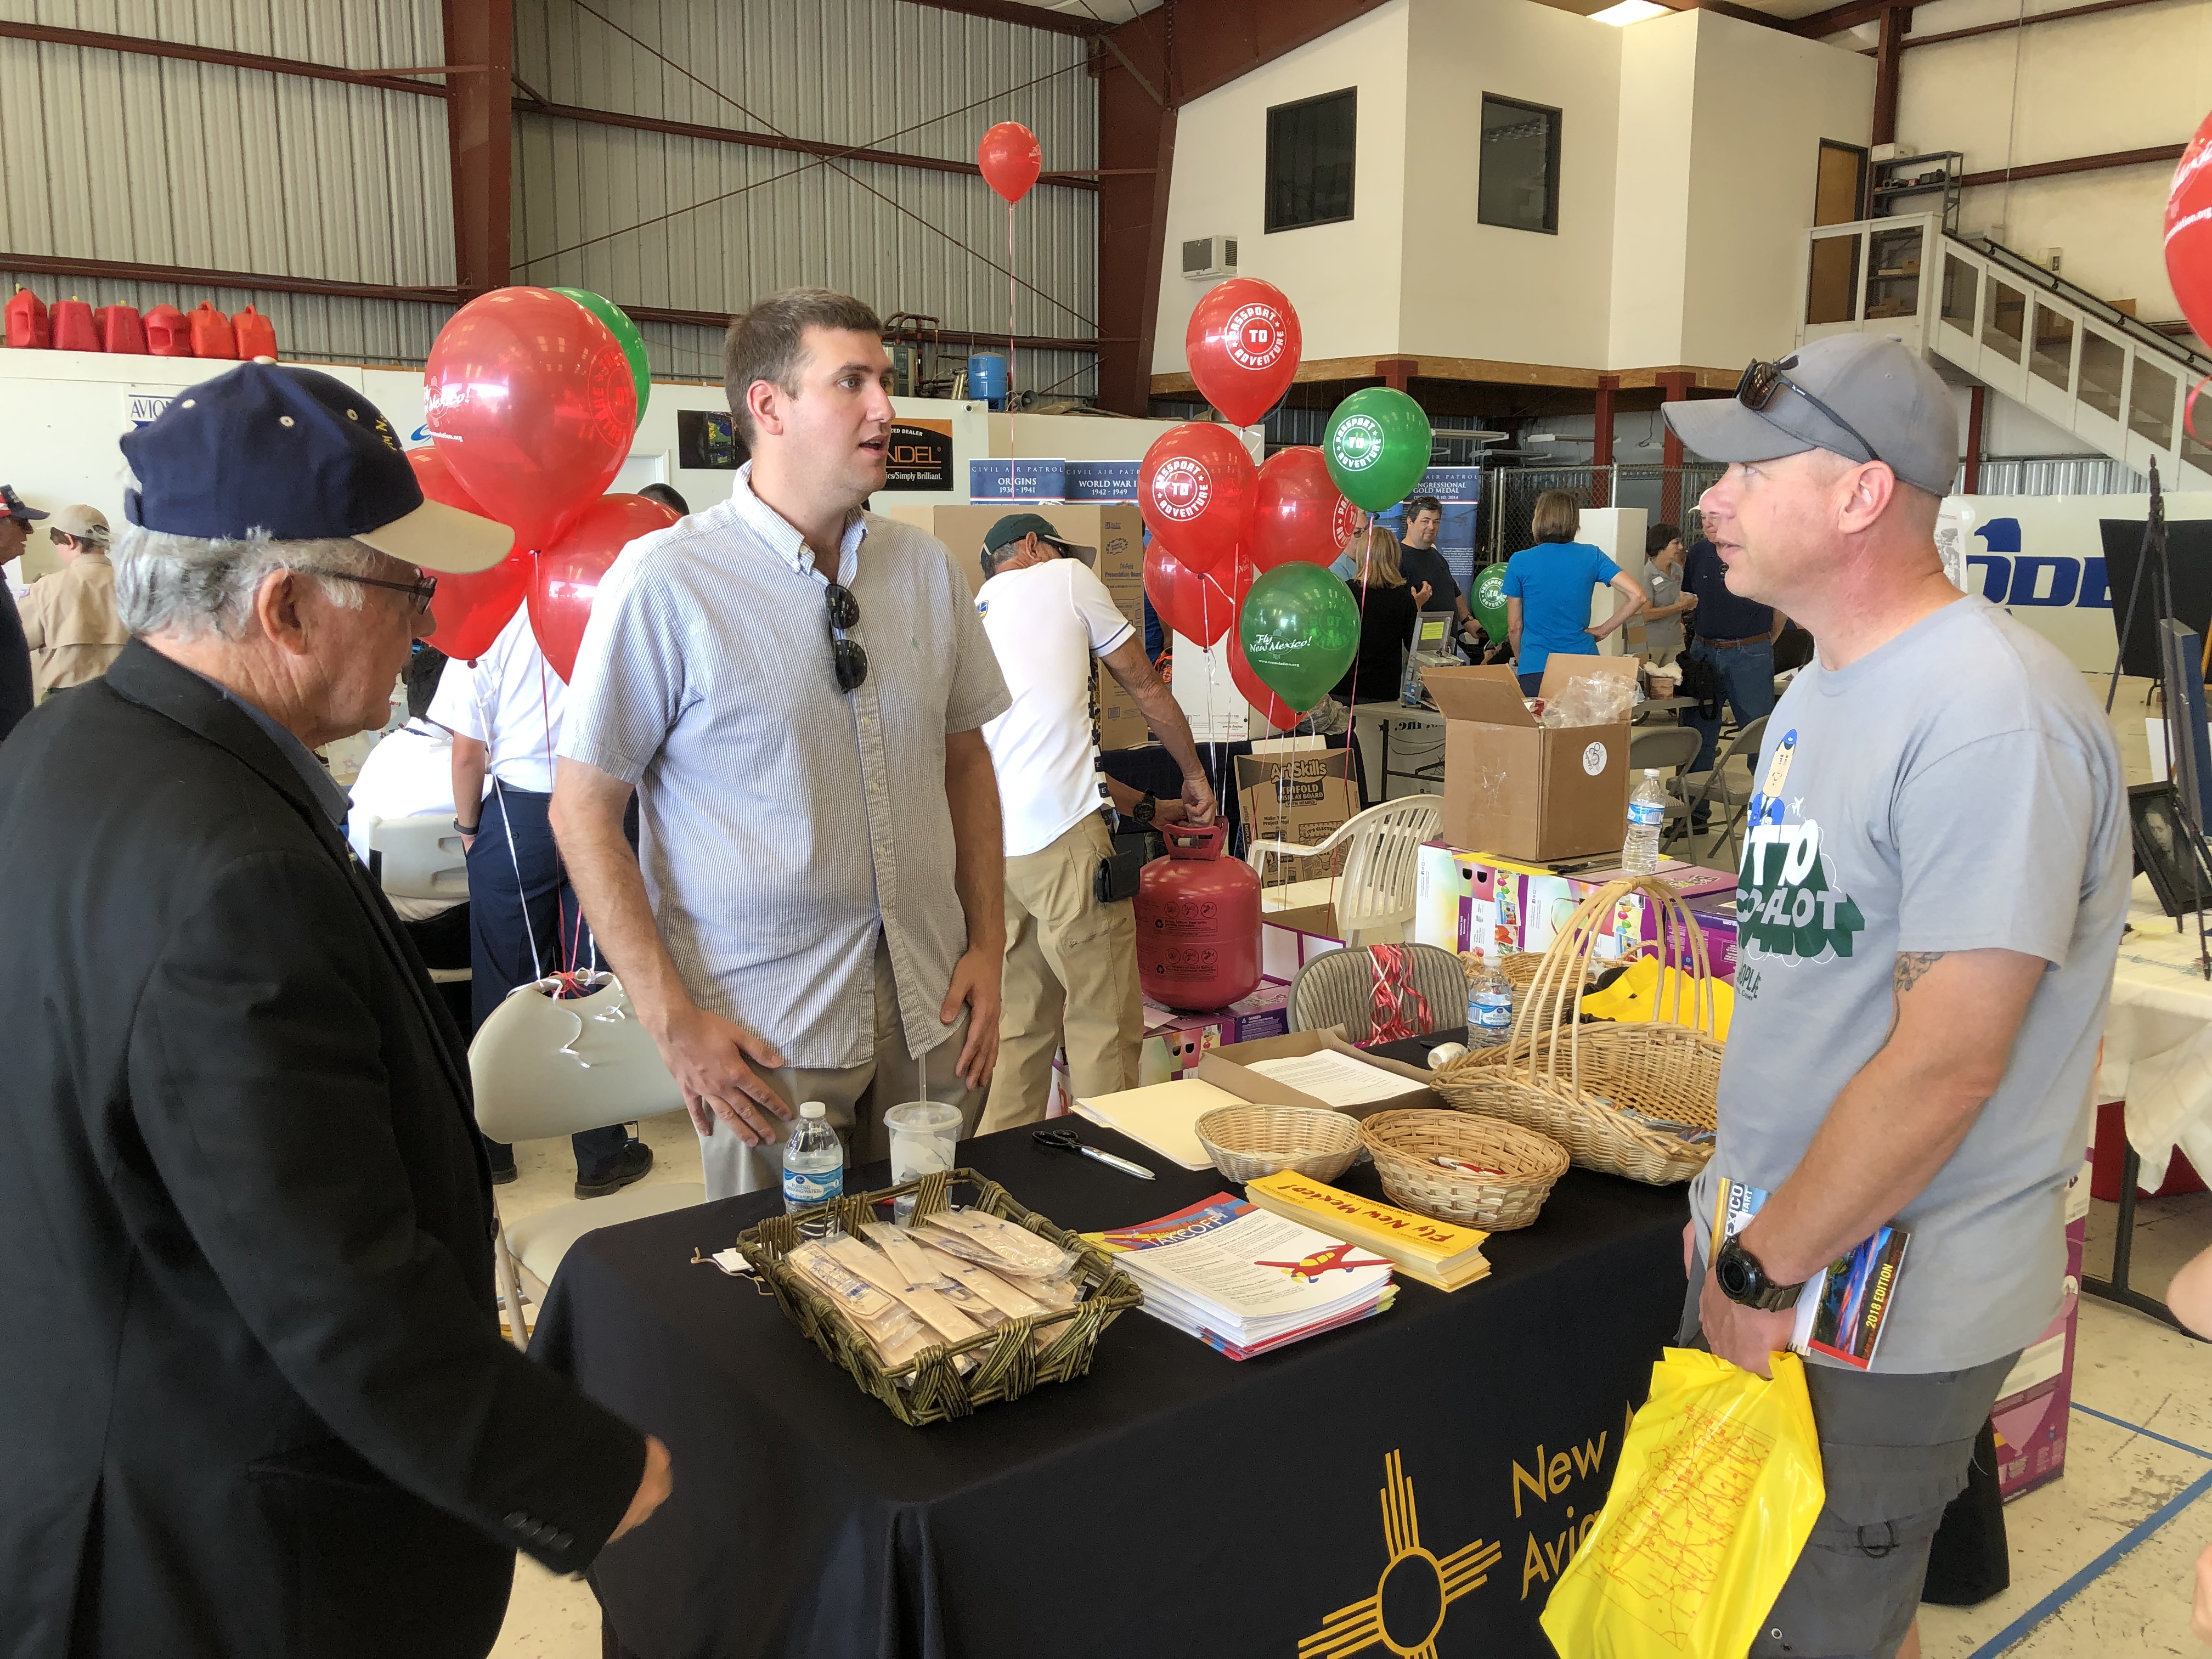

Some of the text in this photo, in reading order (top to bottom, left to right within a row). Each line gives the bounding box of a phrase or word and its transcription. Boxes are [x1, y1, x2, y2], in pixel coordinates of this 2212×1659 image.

[1229, 307, 1276, 341] PASSPORT
[1249, 330, 1267, 342] TO
[1234, 331, 1284, 366] ADVENTURE
[1335, 417, 1376, 443] PASSPORT
[1338, 438, 1381, 468] ADVENTURE
[1349, 437, 1364, 449] TO
[888, 445, 941, 464] NDEL
[886, 472, 916, 481] ics/Simply
[1171, 483, 1189, 496] TO
[1159, 484, 1209, 517] ADVENTURE
[1250, 636, 1312, 652] New Mexico!
[1256, 634, 1273, 645] Fly
[1271, 760, 1327, 780] ArtSkills
[1282, 784, 1319, 793] TRIFOLD
[1277, 1178, 1362, 1214] Mexico!
[1741, 1188, 1753, 1212] HART
[1361, 1211, 1410, 1229] New
[1724, 1185, 1744, 1242] EXICO
[1412, 1225, 1455, 1242] Fly
[1866, 1263, 1894, 1329] 2018 EDITION
[1513, 1430, 1607, 1519] New
